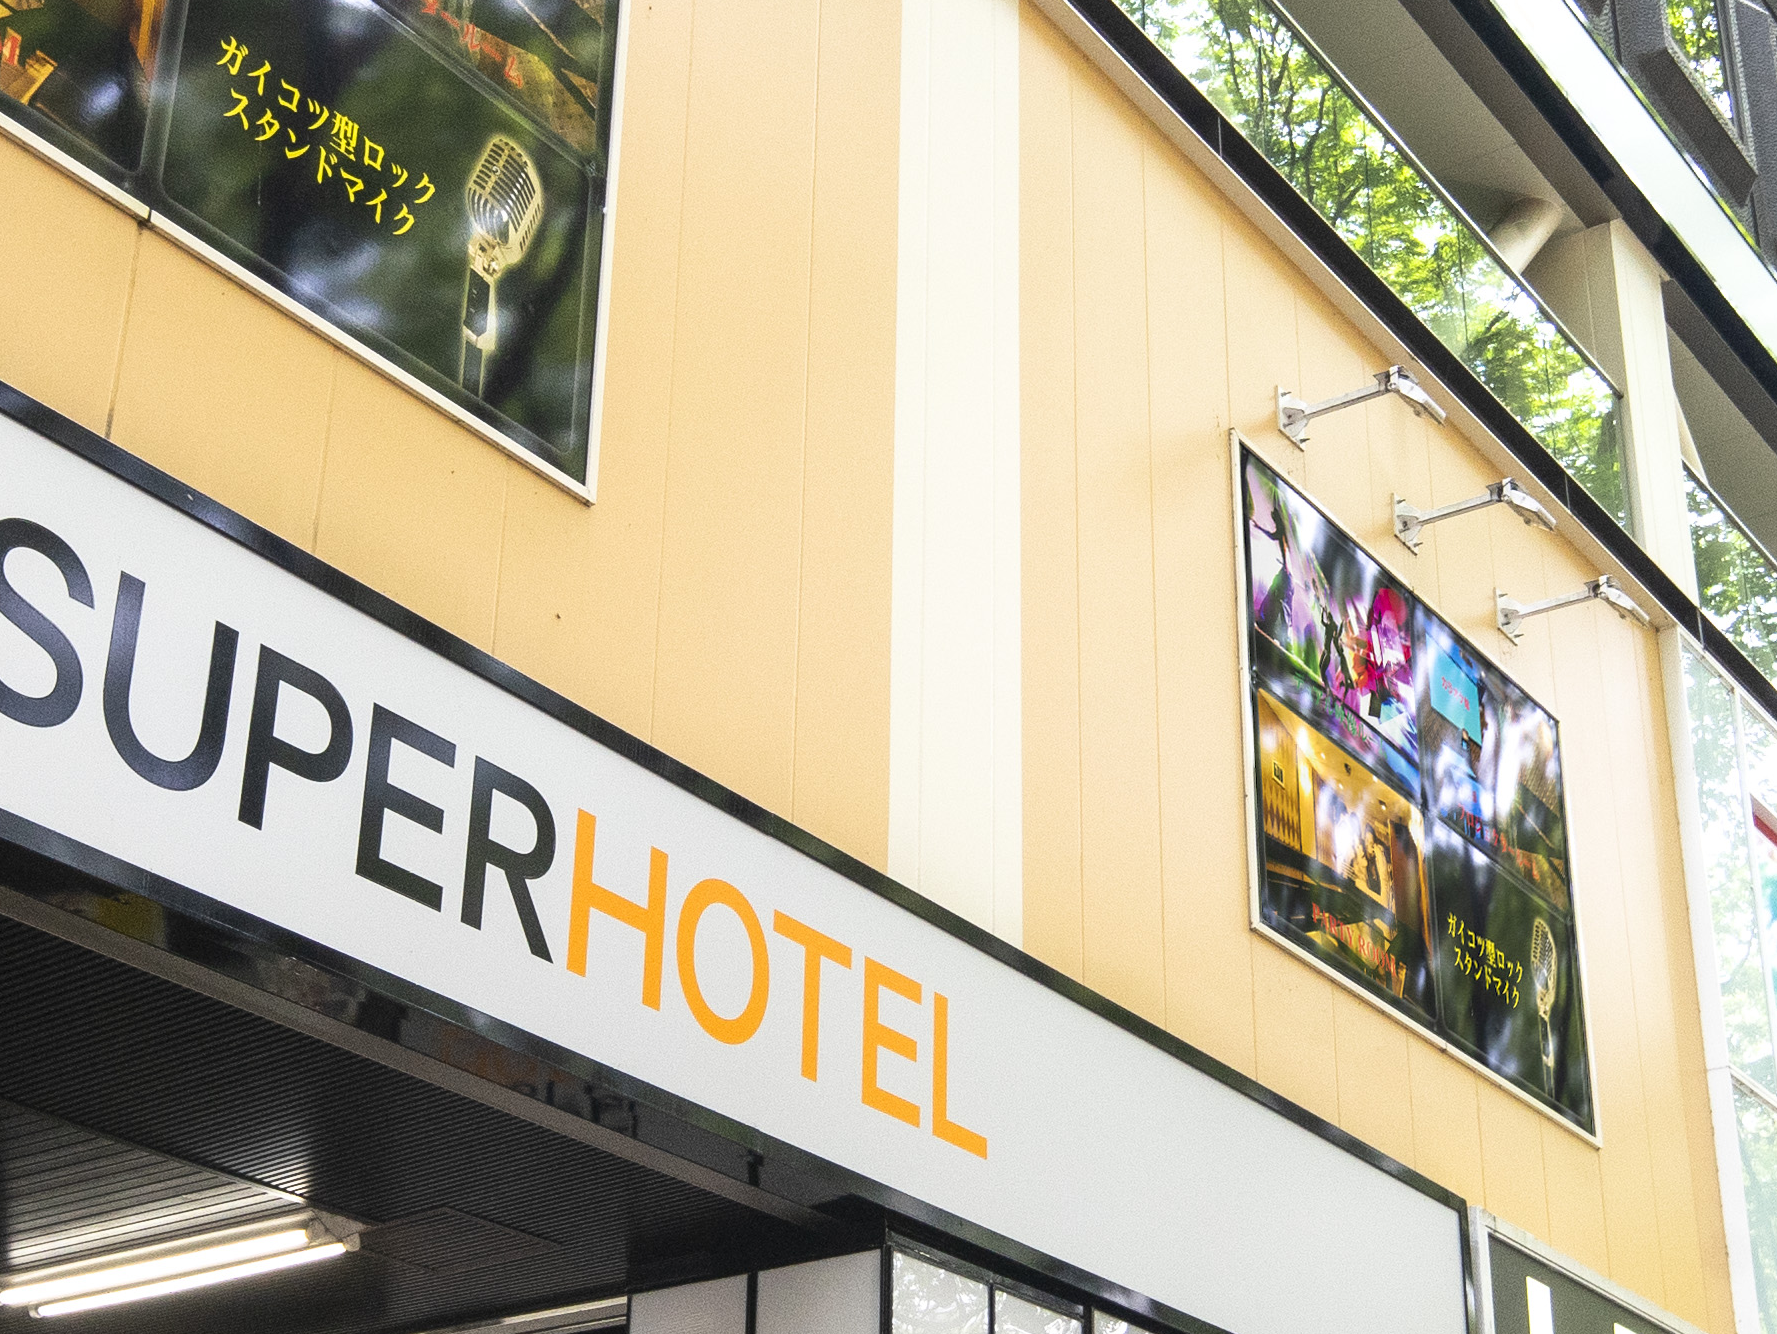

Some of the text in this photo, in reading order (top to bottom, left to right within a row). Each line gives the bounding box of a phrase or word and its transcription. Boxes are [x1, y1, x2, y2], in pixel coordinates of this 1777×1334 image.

[216, 35, 437, 204] ガイコツ型ロック
[223, 87, 417, 236] スタンドマイク
[1312, 901, 1397, 977] PARTY ROOM
[1454, 946, 1520, 1009] スタンドマイク
